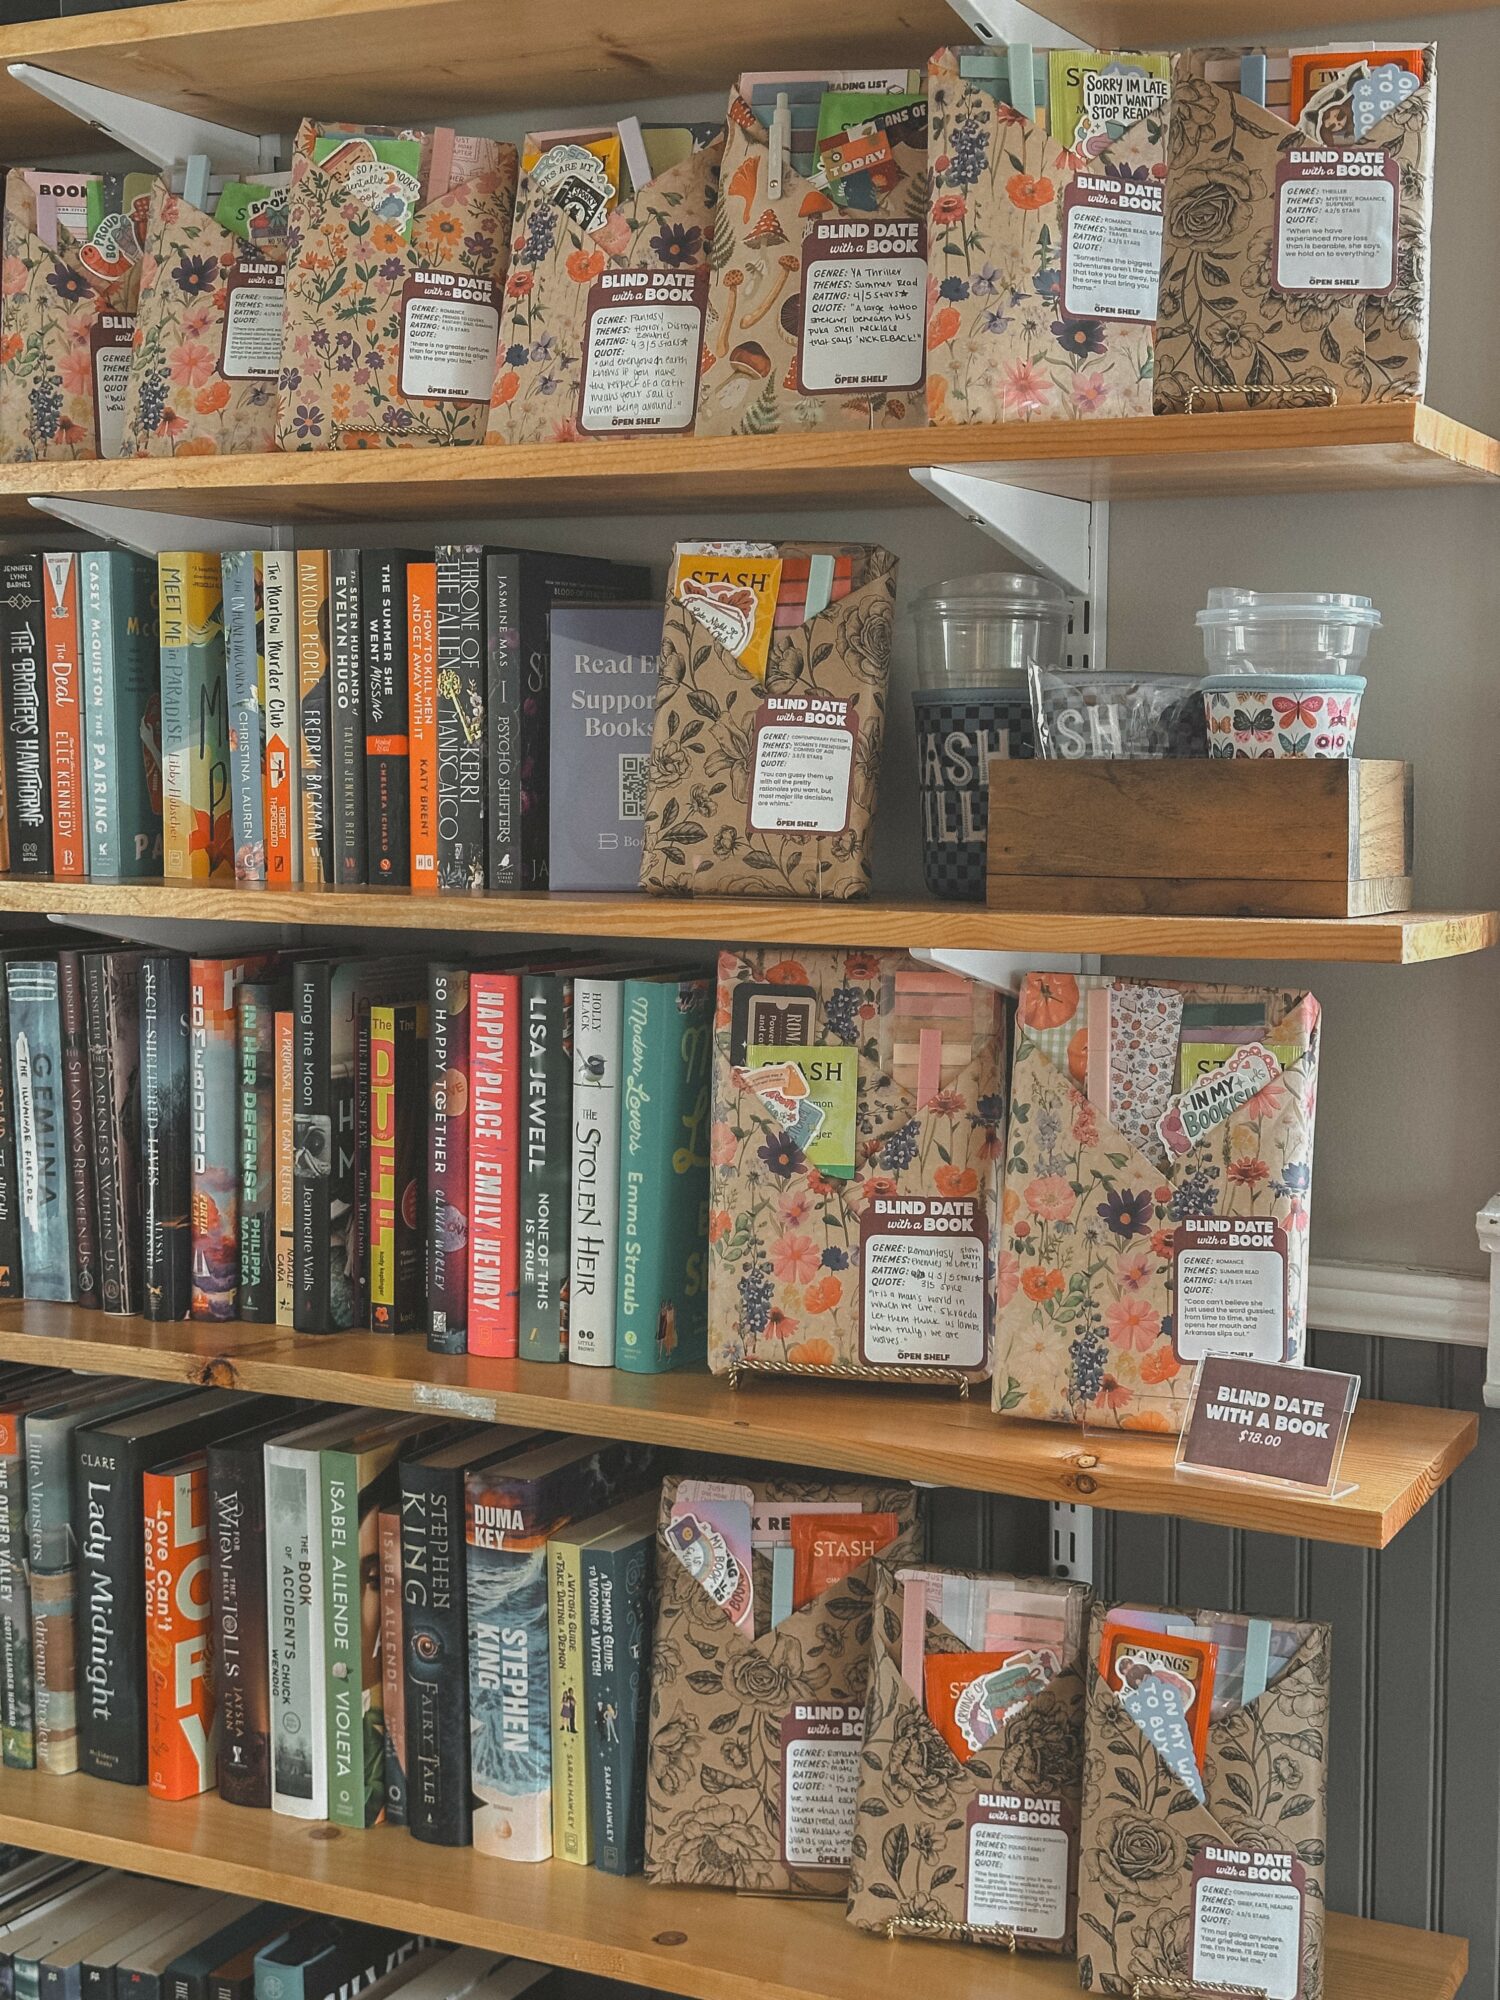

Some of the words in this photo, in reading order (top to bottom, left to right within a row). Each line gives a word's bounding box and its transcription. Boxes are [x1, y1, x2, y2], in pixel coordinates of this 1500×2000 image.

[1087, 75, 1123, 92] SORRY
[1127, 79, 1140, 92] IM
[1143, 79, 1167, 95] LATE
[1094, 93, 1123, 106] DIDNT
[1127, 94, 1154, 107] WANT
[1092, 106, 1120, 120] STOP
[830, 150, 886, 177] TODAY
[1290, 152, 1339, 163] BLIND
[1343, 152, 1384, 163] DATE
[1302, 167, 1326, 175] with
[1337, 165, 1384, 177] BOOK
[1077, 177, 1121, 192] BLIND
[1125, 182, 1162, 197] DATE
[1088, 195, 1109, 204] with
[1110, 197, 1118, 205] a
[1120, 196, 1162, 212] BOOK
[94, 216, 120, 246] PROUD
[818, 224, 869, 238] BLIND
[874, 224, 918, 237] DATE
[1286, 216, 1318, 224] QUOTE:
[830, 242, 854, 254] with
[856, 244, 864, 252] a
[867, 240, 918, 253] BOOK
[415, 272, 455, 286] BLIND
[458, 275, 492, 291] DATE
[602, 274, 649, 288] BLIND
[652, 274, 695, 287] DATE
[813, 280, 851, 289] THEMES:
[814, 269, 847, 277] GENRE:
[851, 268, 864, 277] YA
[867, 268, 901, 276] Thriller
[855, 280, 891, 288] Summer
[424, 287, 444, 296] with
[452, 289, 492, 302] BOOK
[612, 293, 634, 301] with
[645, 289, 693, 301] BOOK
[812, 292, 850, 300] RATING:
[812, 304, 845, 312] QUOTE:
[630, 312, 664, 322] Fantasy
[835, 374, 856, 384] OPEN
[859, 374, 887, 383] SHELF
[89, 562, 100, 611] CASEY
[162, 568, 180, 614] MEET
[267, 562, 279, 581] The
[267, 584, 282, 634] Marlow
[301, 564, 318, 629] ANXIOUS
[336, 576, 348, 647] EVELYN
[11, 621, 35, 653] THE
[165, 617, 180, 643] ME
[370, 620, 379, 662] WENT
[383, 599, 392, 660] SUMMER
[54, 643, 66, 660] The
[268, 640, 284, 695] Murder
[302, 633, 319, 684] PEOPLE
[575, 655, 632, 674] Read
[12, 658, 39, 734] BROTHERS
[52, 663, 74, 707] Deal
[337, 653, 348, 708] HUGO
[384, 667, 393, 695] SHE
[269, 700, 285, 729] Club
[768, 699, 807, 710] BLIND
[811, 700, 847, 713] DATE
[777, 713, 795, 722] with
[805, 713, 846, 726] BOOK
[56, 731, 69, 763] ELLE
[238, 712, 251, 782] CHRISTINA
[304, 710, 321, 767] FREDRIK
[585, 718, 653, 737] Books
[16, 740, 43, 828] HAWTHORNE
[94, 744, 107, 833] PAIRING
[460, 748, 479, 803] KERRI
[58, 768, 73, 838] KENNEDY
[241, 787, 252, 839] LAUREN
[307, 775, 323, 841] BACKMAN
[303, 983, 315, 1025] Hang
[582, 992, 590, 1031] BLACK
[592, 992, 601, 1032] HOLLY
[303, 1030, 314, 1055] the
[476, 992, 505, 1065] HAPPY
[529, 998, 547, 1057] LISA
[631, 997, 649, 1074] Modern
[243, 1036, 256, 1085] HER
[303, 1061, 313, 1106] Moon
[1190, 1091, 1209, 1110] IN
[1210, 1076, 1234, 1102] MY
[476, 1072, 502, 1140] PLACE
[529, 1067, 546, 1173] JEWELL
[626, 1078, 649, 1156] Lovers
[32, 1053, 57, 1207] GEMINA
[242, 1092, 257, 1203] DEFENSE
[577, 1122, 601, 1227] STOLEN
[475, 1162, 502, 1230] EMILY
[626, 1172, 643, 1236] Emma
[875, 1201, 925, 1215] BLIND
[930, 1202, 973, 1215] DATE
[888, 1221, 912, 1229] with
[924, 1218, 973, 1231] BOOK
[1186, 1220, 1231, 1232] BLIND
[1235, 1221, 1273, 1233] DATE
[1197, 1236, 1218, 1244] with
[1229, 1235, 1274, 1247] BOOK
[472, 1236, 501, 1311] HENRY
[575, 1237, 604, 1298] HEIR
[623, 1241, 641, 1315] Straub
[1206, 1403, 1253, 1425] WITH
[1256, 1413, 1270, 1428] A
[1275, 1415, 1330, 1438] BOOK
[1217, 1386, 1270, 1408] BLIND
[1274, 1395, 1324, 1417] DATE
[1238, 1430, 1281, 1447] $18.00
[81, 1453, 116, 1470] CLARE
[82, 1481, 111, 1561] Lady
[156, 1500, 172, 1561] Love
[330, 1480, 345, 1549] ISABEL
[474, 1504, 524, 1530] DUMA
[402, 1490, 427, 1606] KING
[431, 1493, 449, 1609] STEPHEN
[474, 1527, 505, 1550] KEY
[814, 1541, 875, 1557] STASH
[157, 1567, 172, 1632] Can't
[300, 1561, 311, 1605] BOOK
[333, 1556, 348, 1649] ALLENDE
[283, 1564, 296, 1659] ACCIDENTS
[89, 1572, 115, 1721] Midnight
[477, 1622, 501, 1691] KING
[502, 1628, 528, 1753] STEPHEN
[335, 1690, 350, 1778] VIOLETA
[1206, 1847, 1250, 1864] BLIND
[1253, 1851, 1292, 1868] DATE
[1216, 1865, 1238, 1875] with
[1239, 1866, 1246, 1876] a
[1247, 1867, 1293, 1882] BOOK
